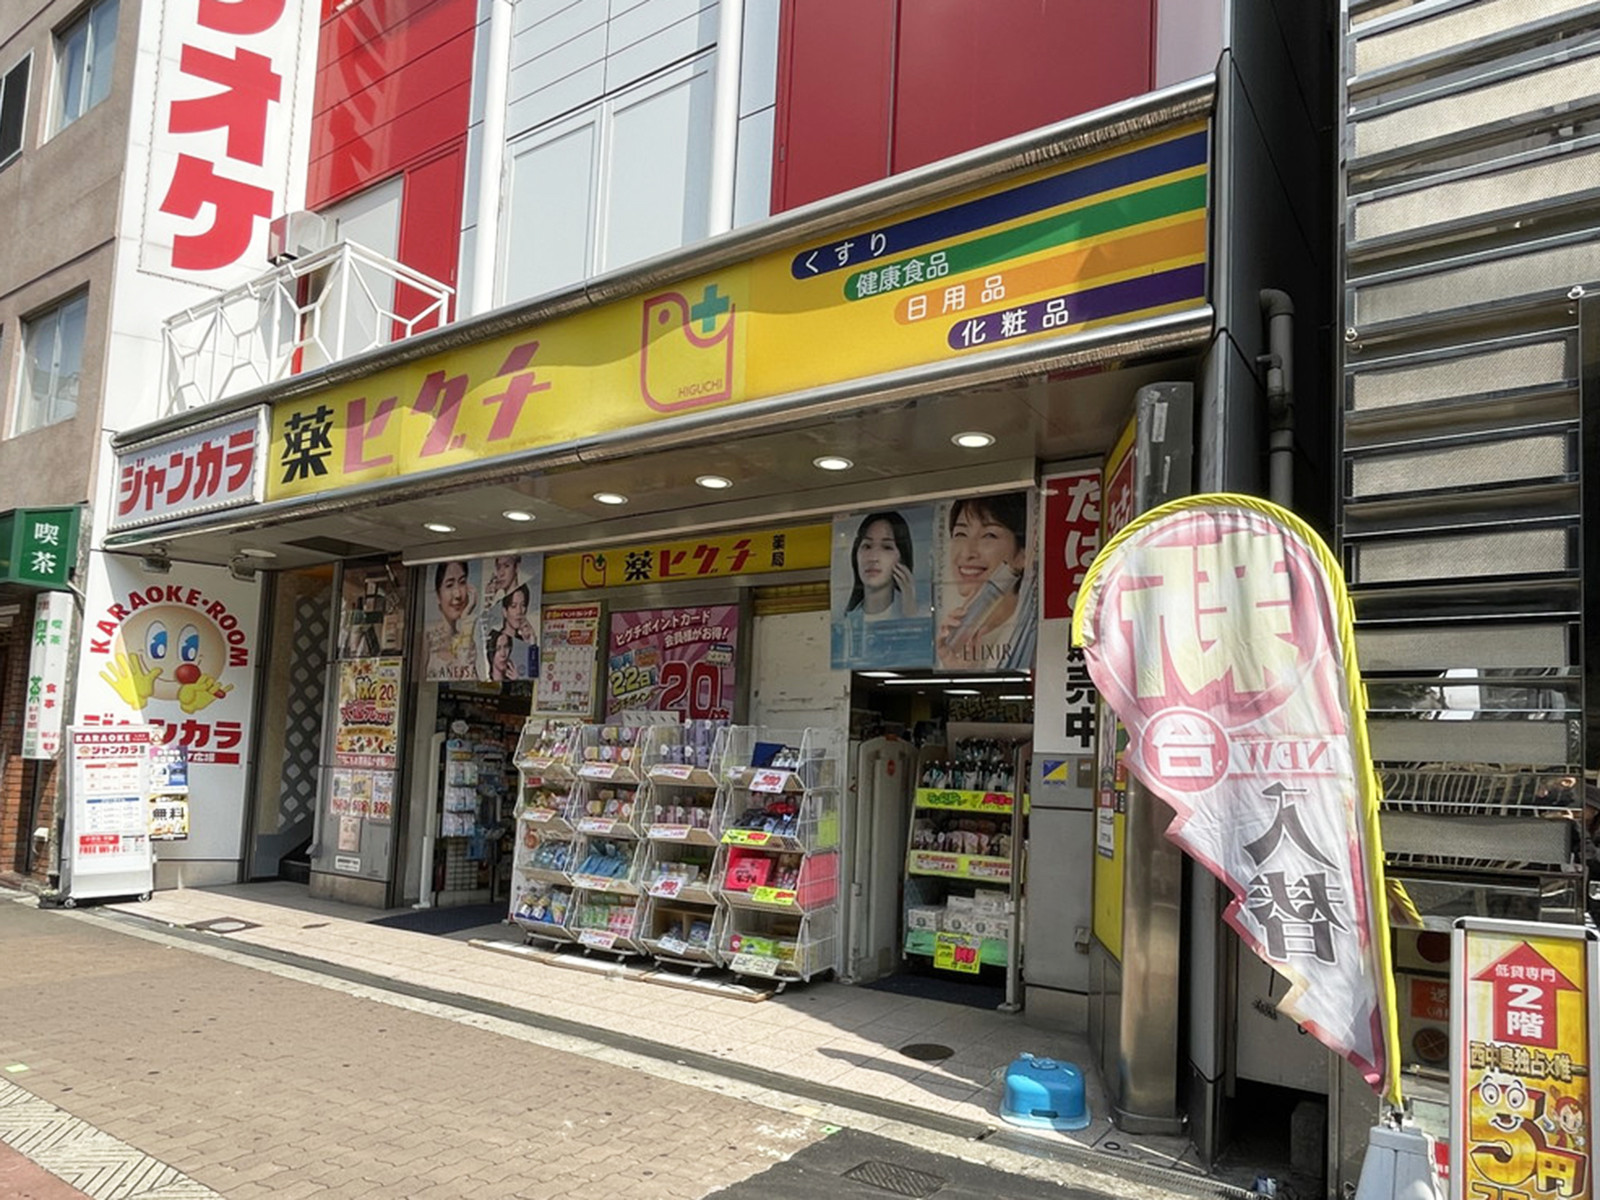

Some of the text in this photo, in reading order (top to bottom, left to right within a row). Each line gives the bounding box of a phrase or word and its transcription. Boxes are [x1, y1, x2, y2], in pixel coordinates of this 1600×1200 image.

[806, 233, 888, 273] くすり
[855, 252, 950, 298] 健康食品
[907, 274, 1006, 319] 日用品
[961, 298, 1070, 346] 化粧品
[679, 378, 723, 397] HIGUCHI
[118, 429, 255, 516] ジャンカラ
[31, 522, 60, 575] 喫茶
[615, 610, 711, 646] ヒグチポイントカード
[963, 643, 1013, 662] ELIXIR
[75, 735, 131, 743] KARAOKE
[91, 745, 139, 755] ジャンカラ
[151, 807, 185, 822] 無料
[1495, 964, 1556, 982] 低貸専門
